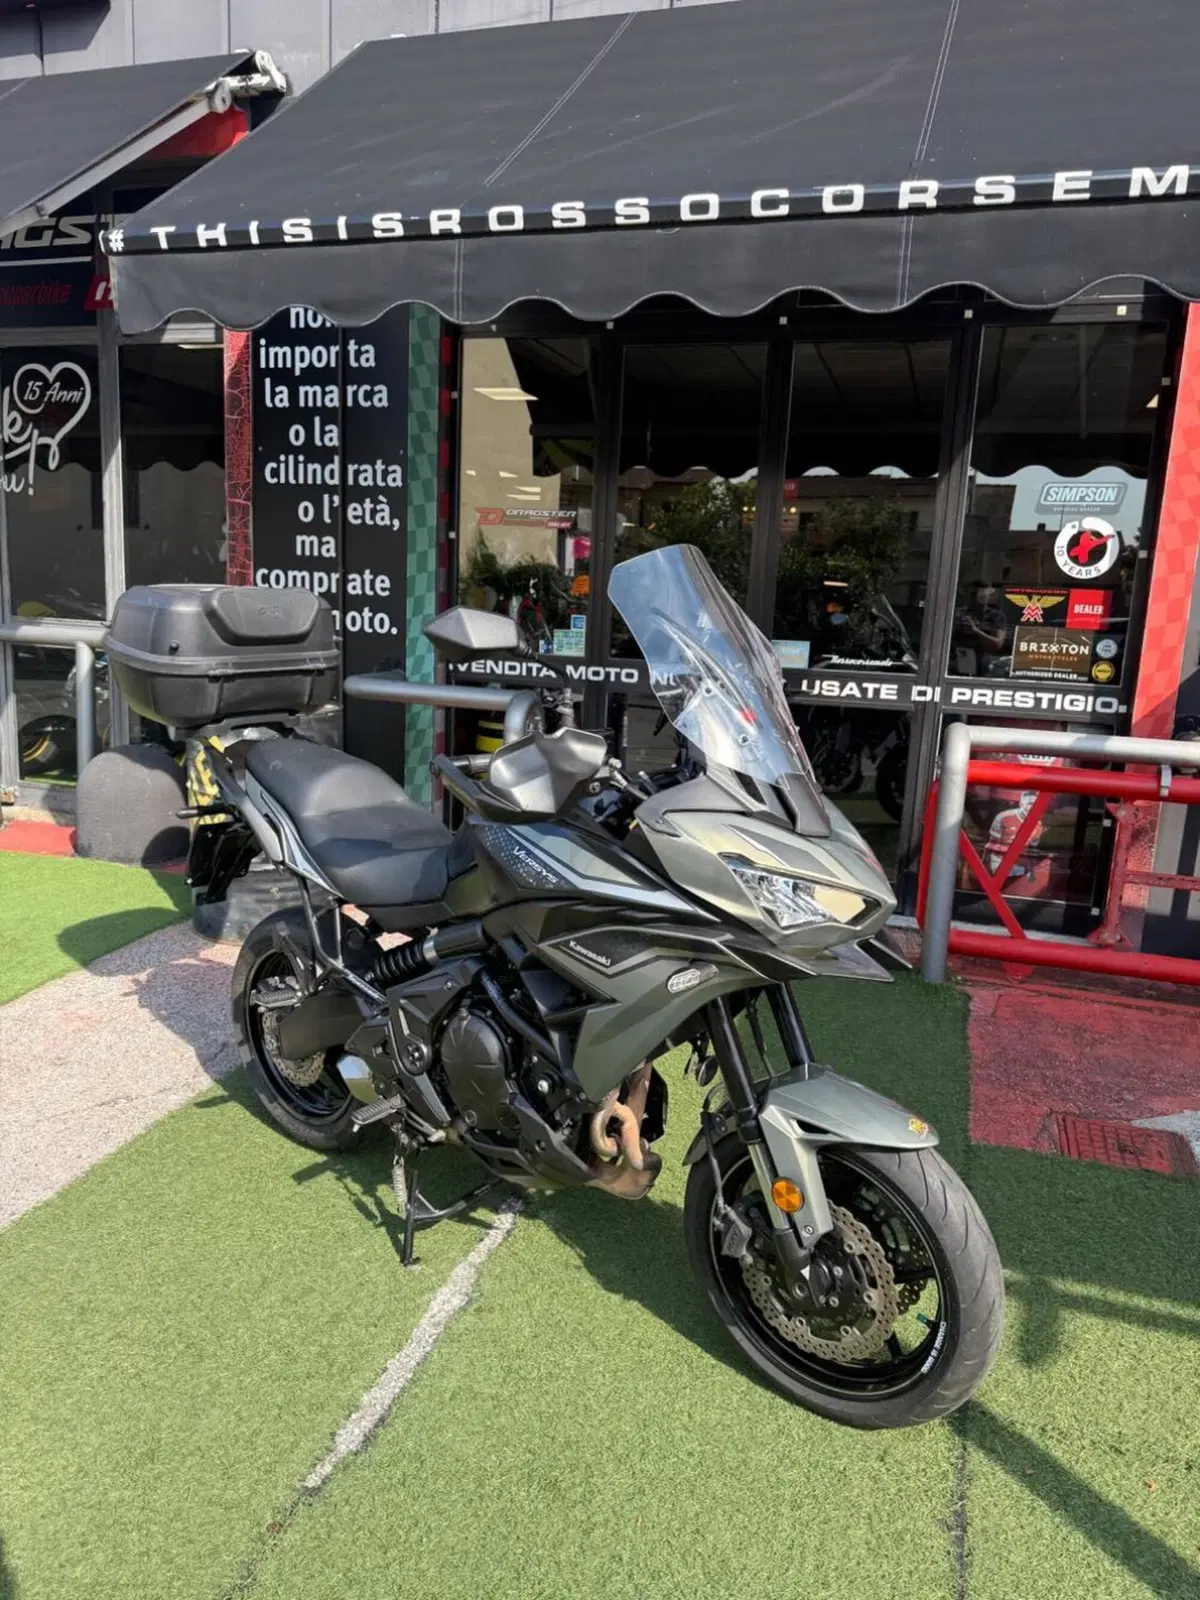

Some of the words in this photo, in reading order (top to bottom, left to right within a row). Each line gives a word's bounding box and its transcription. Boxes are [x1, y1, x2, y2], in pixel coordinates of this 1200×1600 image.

[259, 338, 376, 376] importa
[24, 381, 43, 400] 15
[44, 381, 84, 402] Anni
[264, 377, 290, 408] la
[298, 384, 389, 408] marca
[288, 424, 306, 446] o
[314, 416, 339, 447] la
[264, 454, 403, 488] cilindrata
[1047, 487, 1118, 502] SIMPSON
[298, 500, 315, 523] o
[506, 508, 577, 517] DRAGSTER
[296, 534, 336, 558] ma
[1062, 560, 1102, 577] YEARS
[256, 568, 391, 597] comprate
[1073, 604, 1104, 615] DEALER
[1019, 641, 1090, 655] BRIXTON
[1015, 670, 1052, 678] AUTHORIZED
[1054, 672, 1078, 680] DEALER
[566, 664, 639, 683] MOTO
[801, 679, 899, 700] USATE
[911, 685, 941, 703] DI
[951, 687, 1128, 713] PRESTIGIO.
[568, 940, 612, 967] Kawasaki
